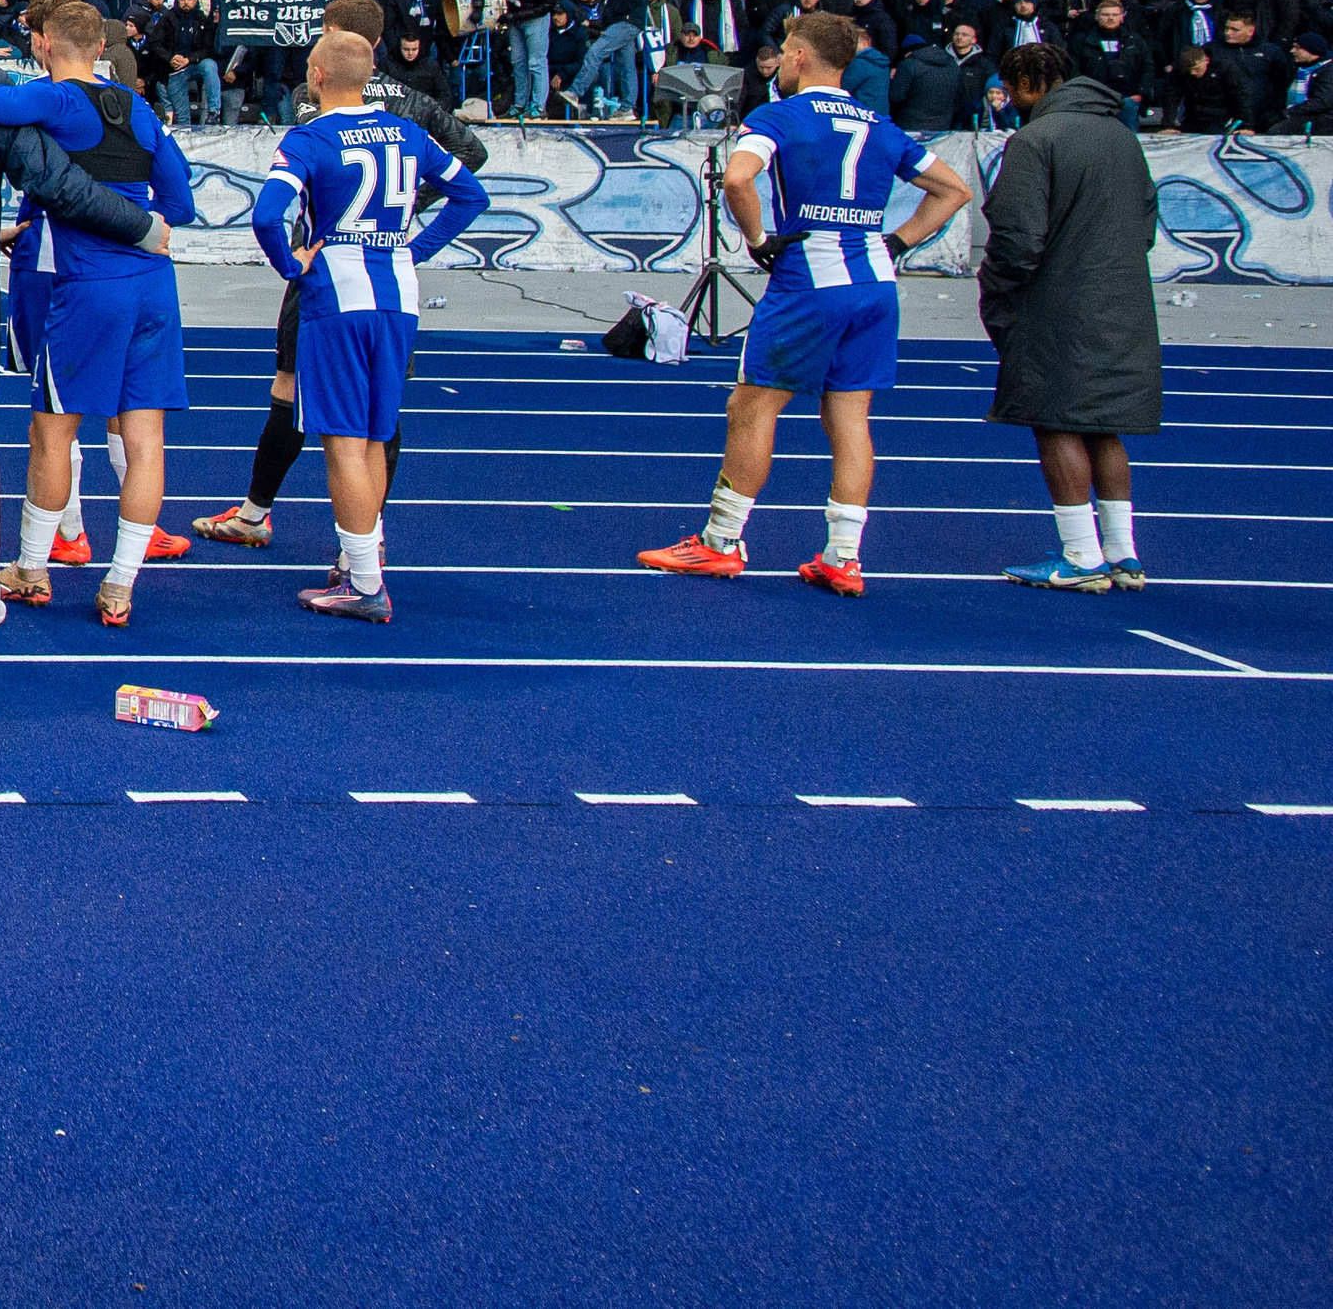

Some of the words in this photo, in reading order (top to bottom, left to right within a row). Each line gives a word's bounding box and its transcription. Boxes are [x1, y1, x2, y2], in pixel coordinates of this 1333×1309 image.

[227, 5, 270, 21] alle
[384, 83, 406, 99] BSC
[810, 99, 858, 118] HERTHA
[338, 126, 386, 146] HERTHA
[383, 126, 406, 143] BSC
[831, 117, 870, 200] 7
[335, 144, 418, 233] 24
[798, 203, 884, 226] NIEDERLECHNER
